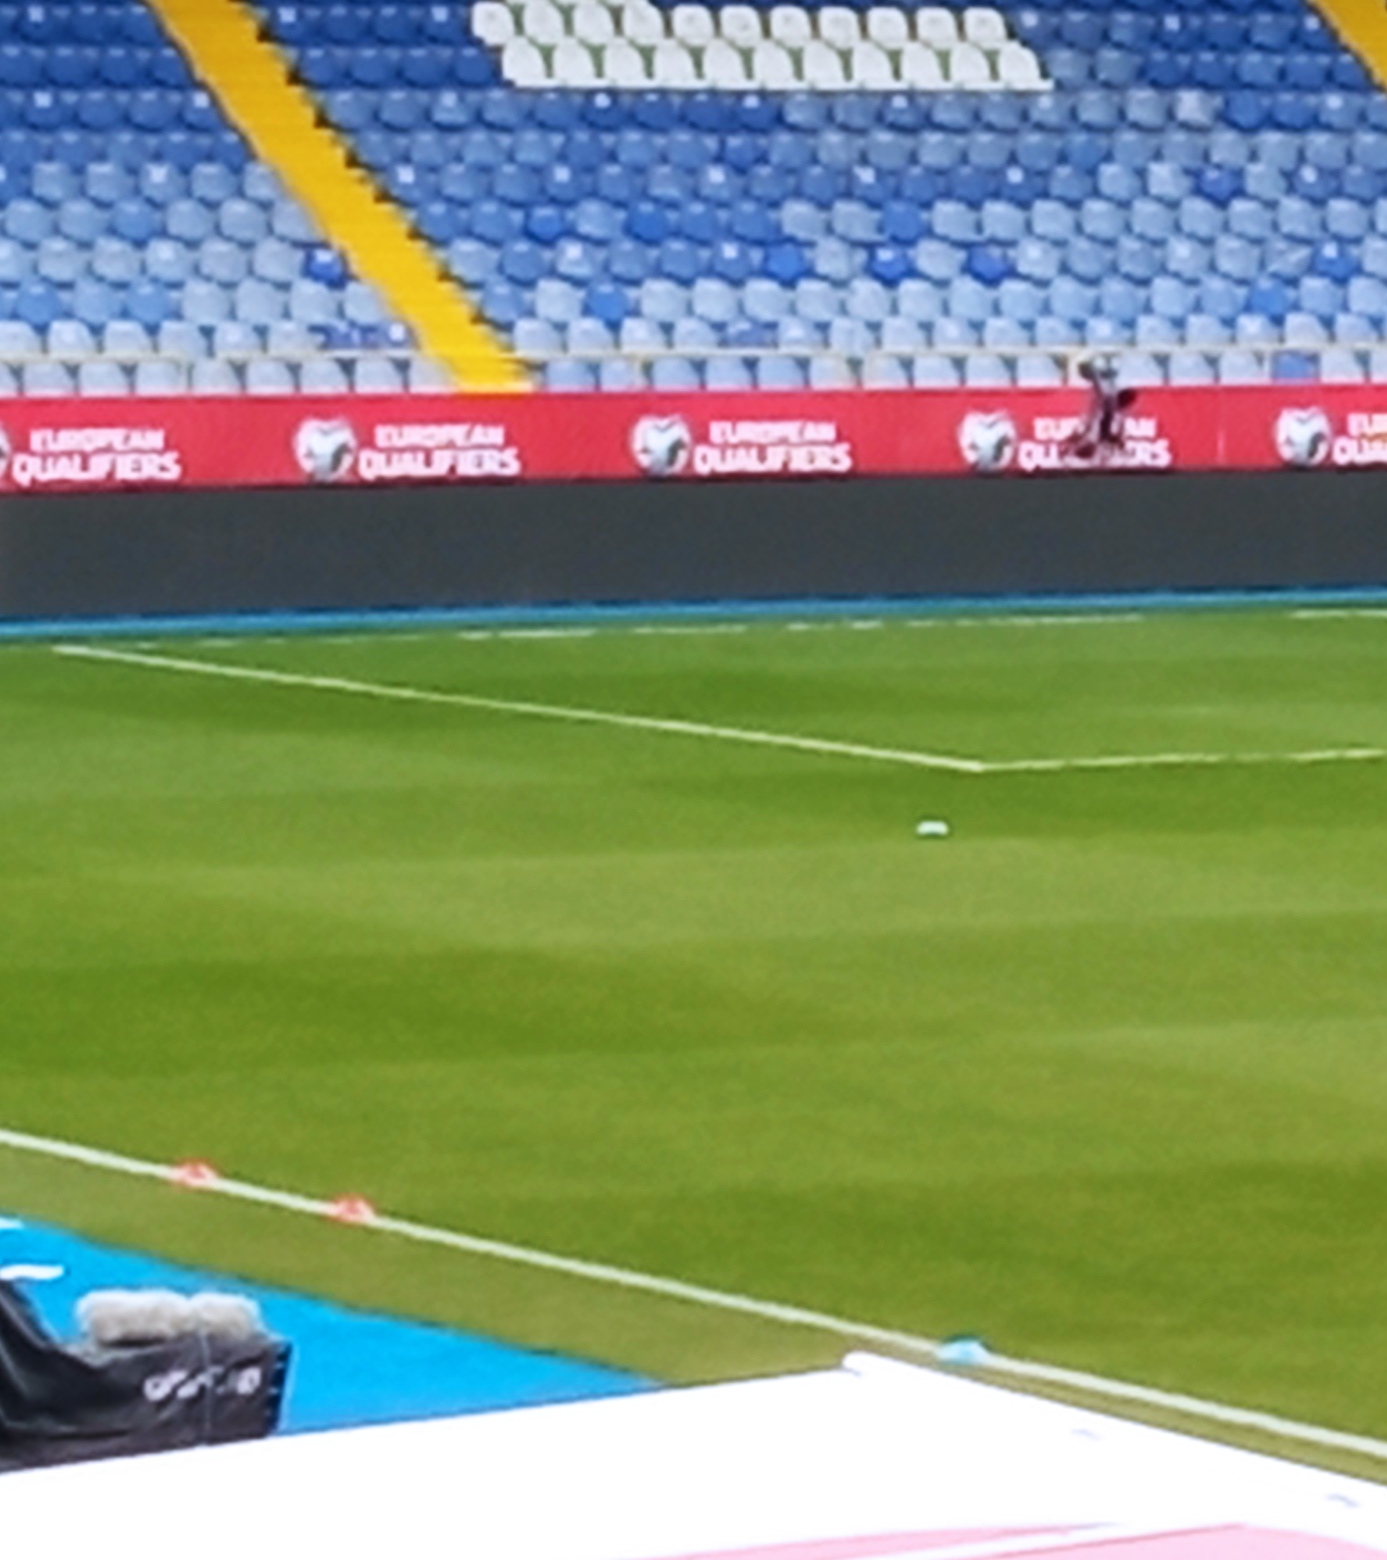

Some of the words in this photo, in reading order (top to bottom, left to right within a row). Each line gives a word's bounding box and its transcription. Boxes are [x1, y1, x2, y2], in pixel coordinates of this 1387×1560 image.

[30, 428, 165, 452] EUROPEAN
[374, 424, 504, 448] EUROPEAN
[709, 421, 836, 444] EUROPEAN
[12, 450, 182, 487] QUALIFIERS
[358, 447, 521, 481] QUALIFIERS
[693, 442, 852, 475] QUALIFIERS
